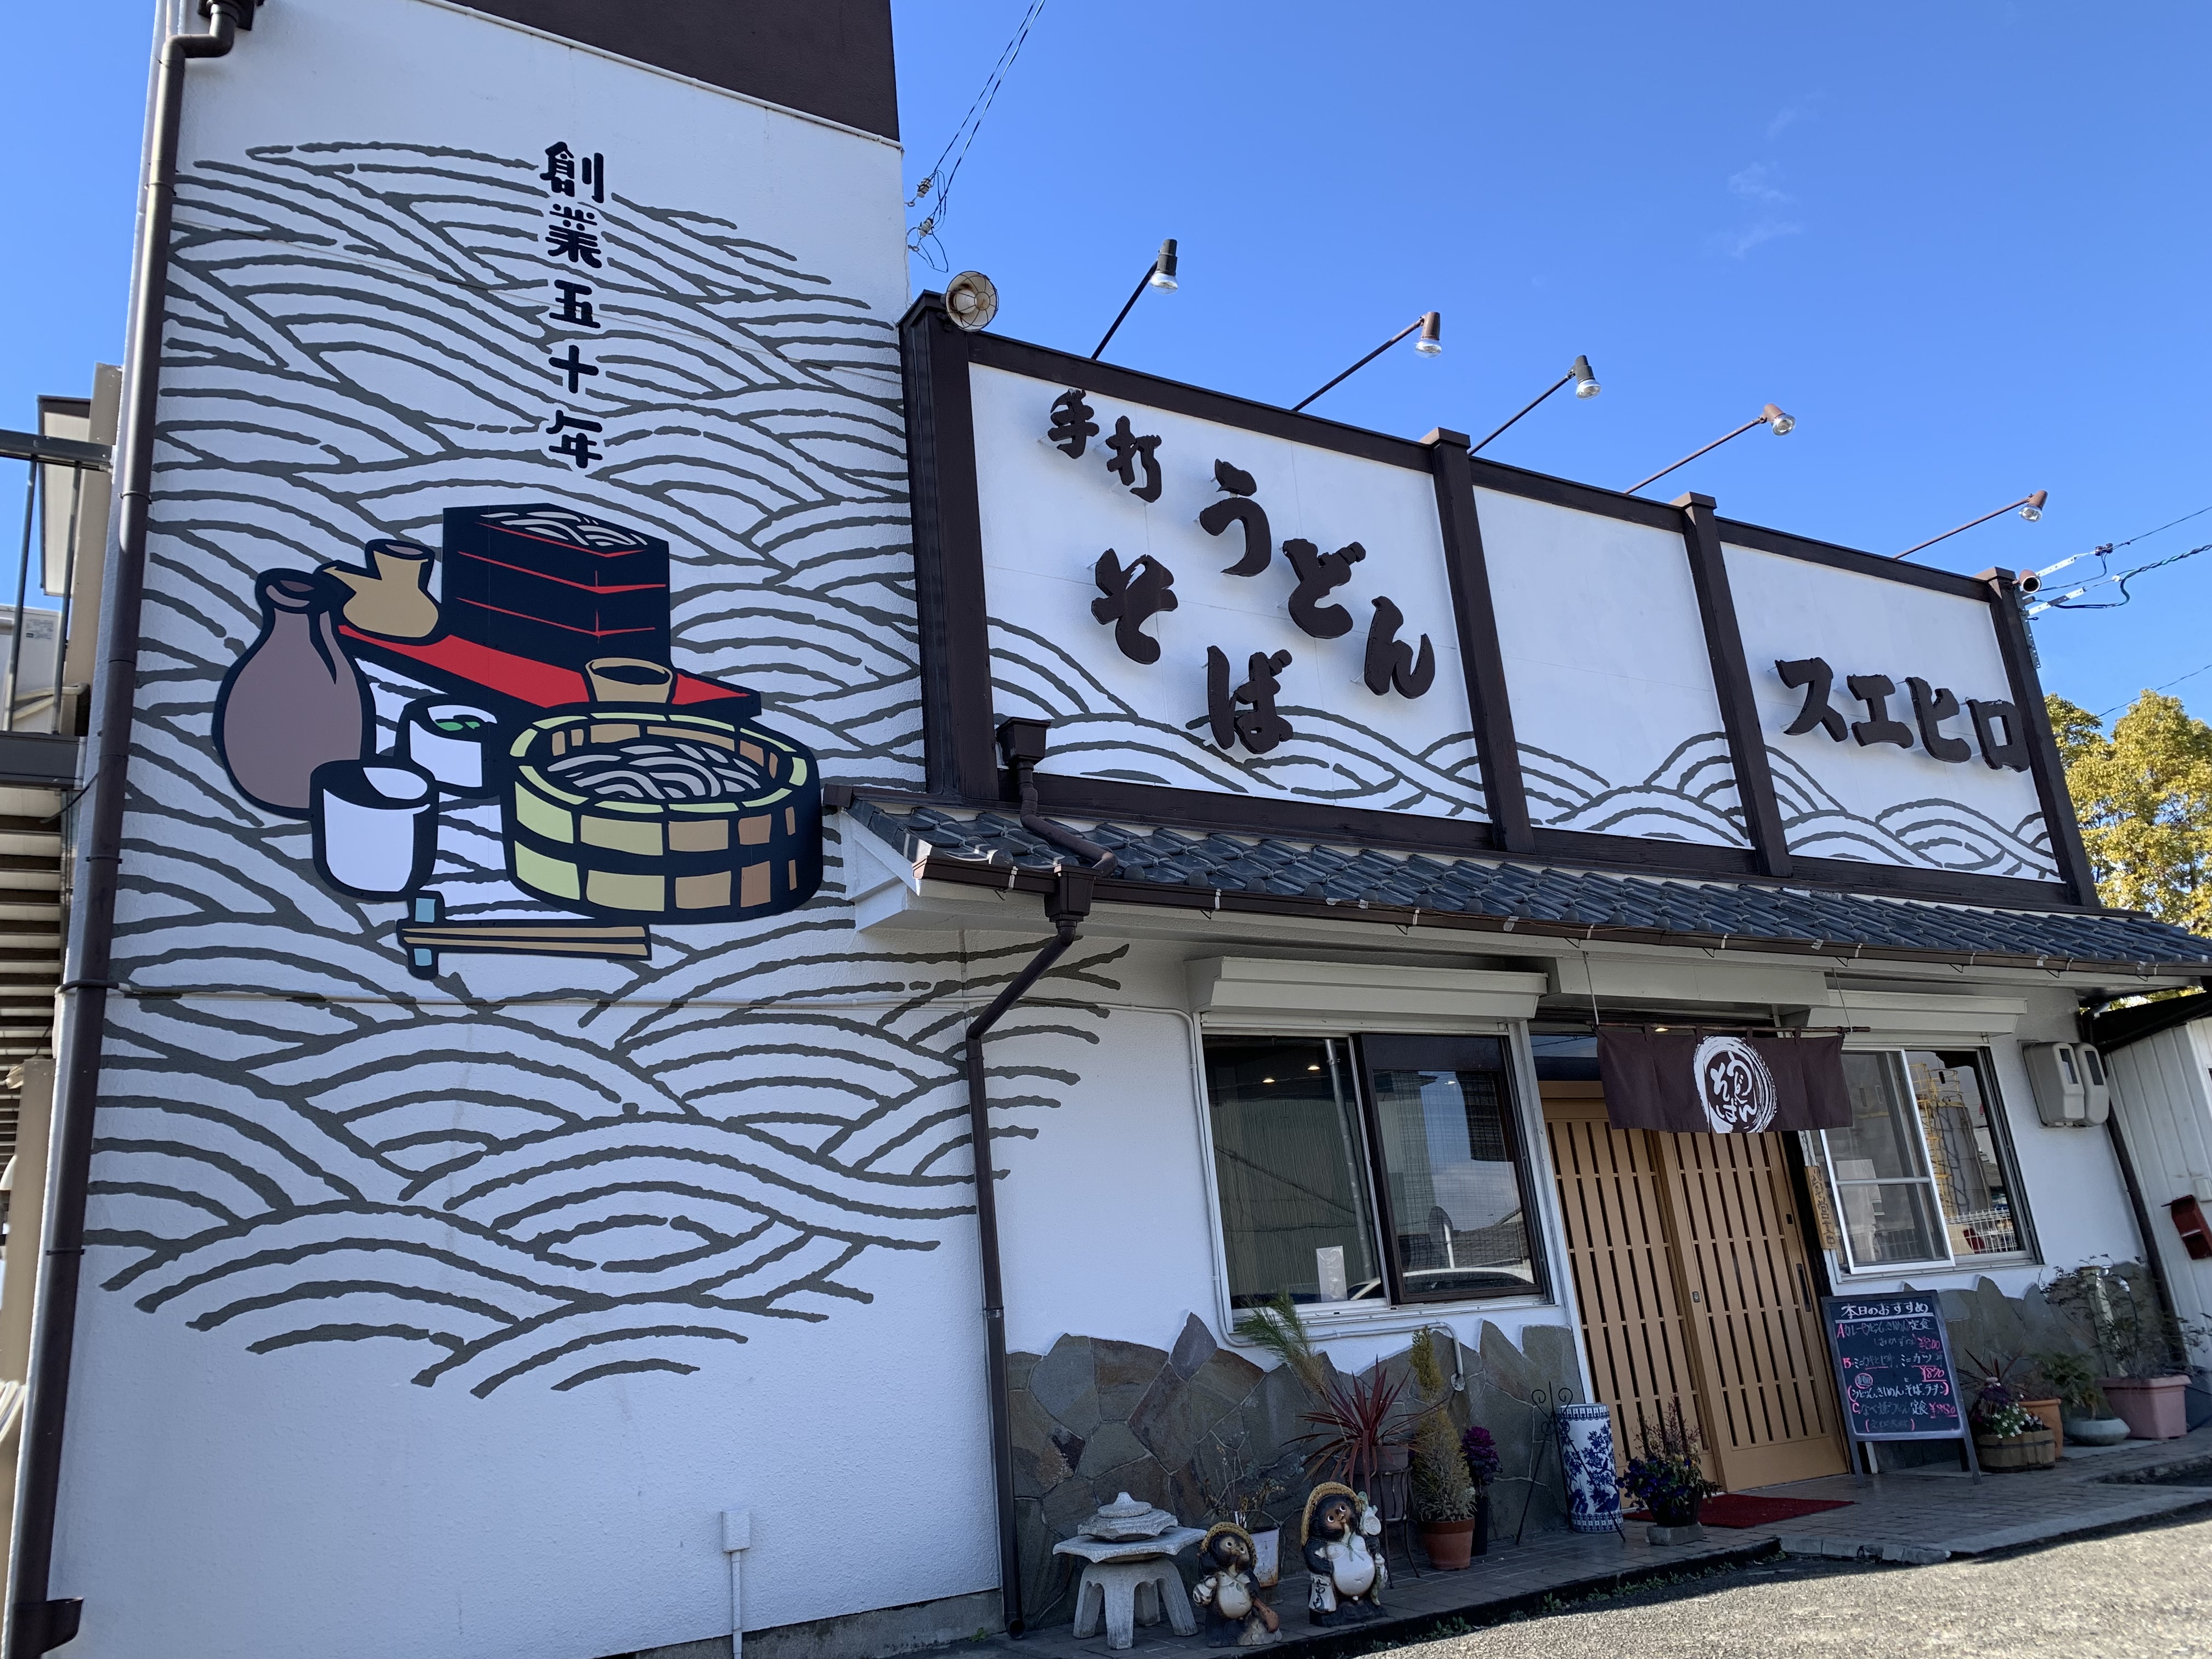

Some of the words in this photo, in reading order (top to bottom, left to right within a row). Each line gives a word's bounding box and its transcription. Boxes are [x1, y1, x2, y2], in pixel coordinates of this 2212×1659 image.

[540, 141, 604, 469] 創業五十年
[1048, 389, 1162, 503] 手打
[1200, 459, 1436, 699] うどん
[1091, 549, 1294, 754] そば
[1775, 657, 2030, 772] スエヒロ
[1841, 1302, 1929, 1319] 本日のおすすめ
